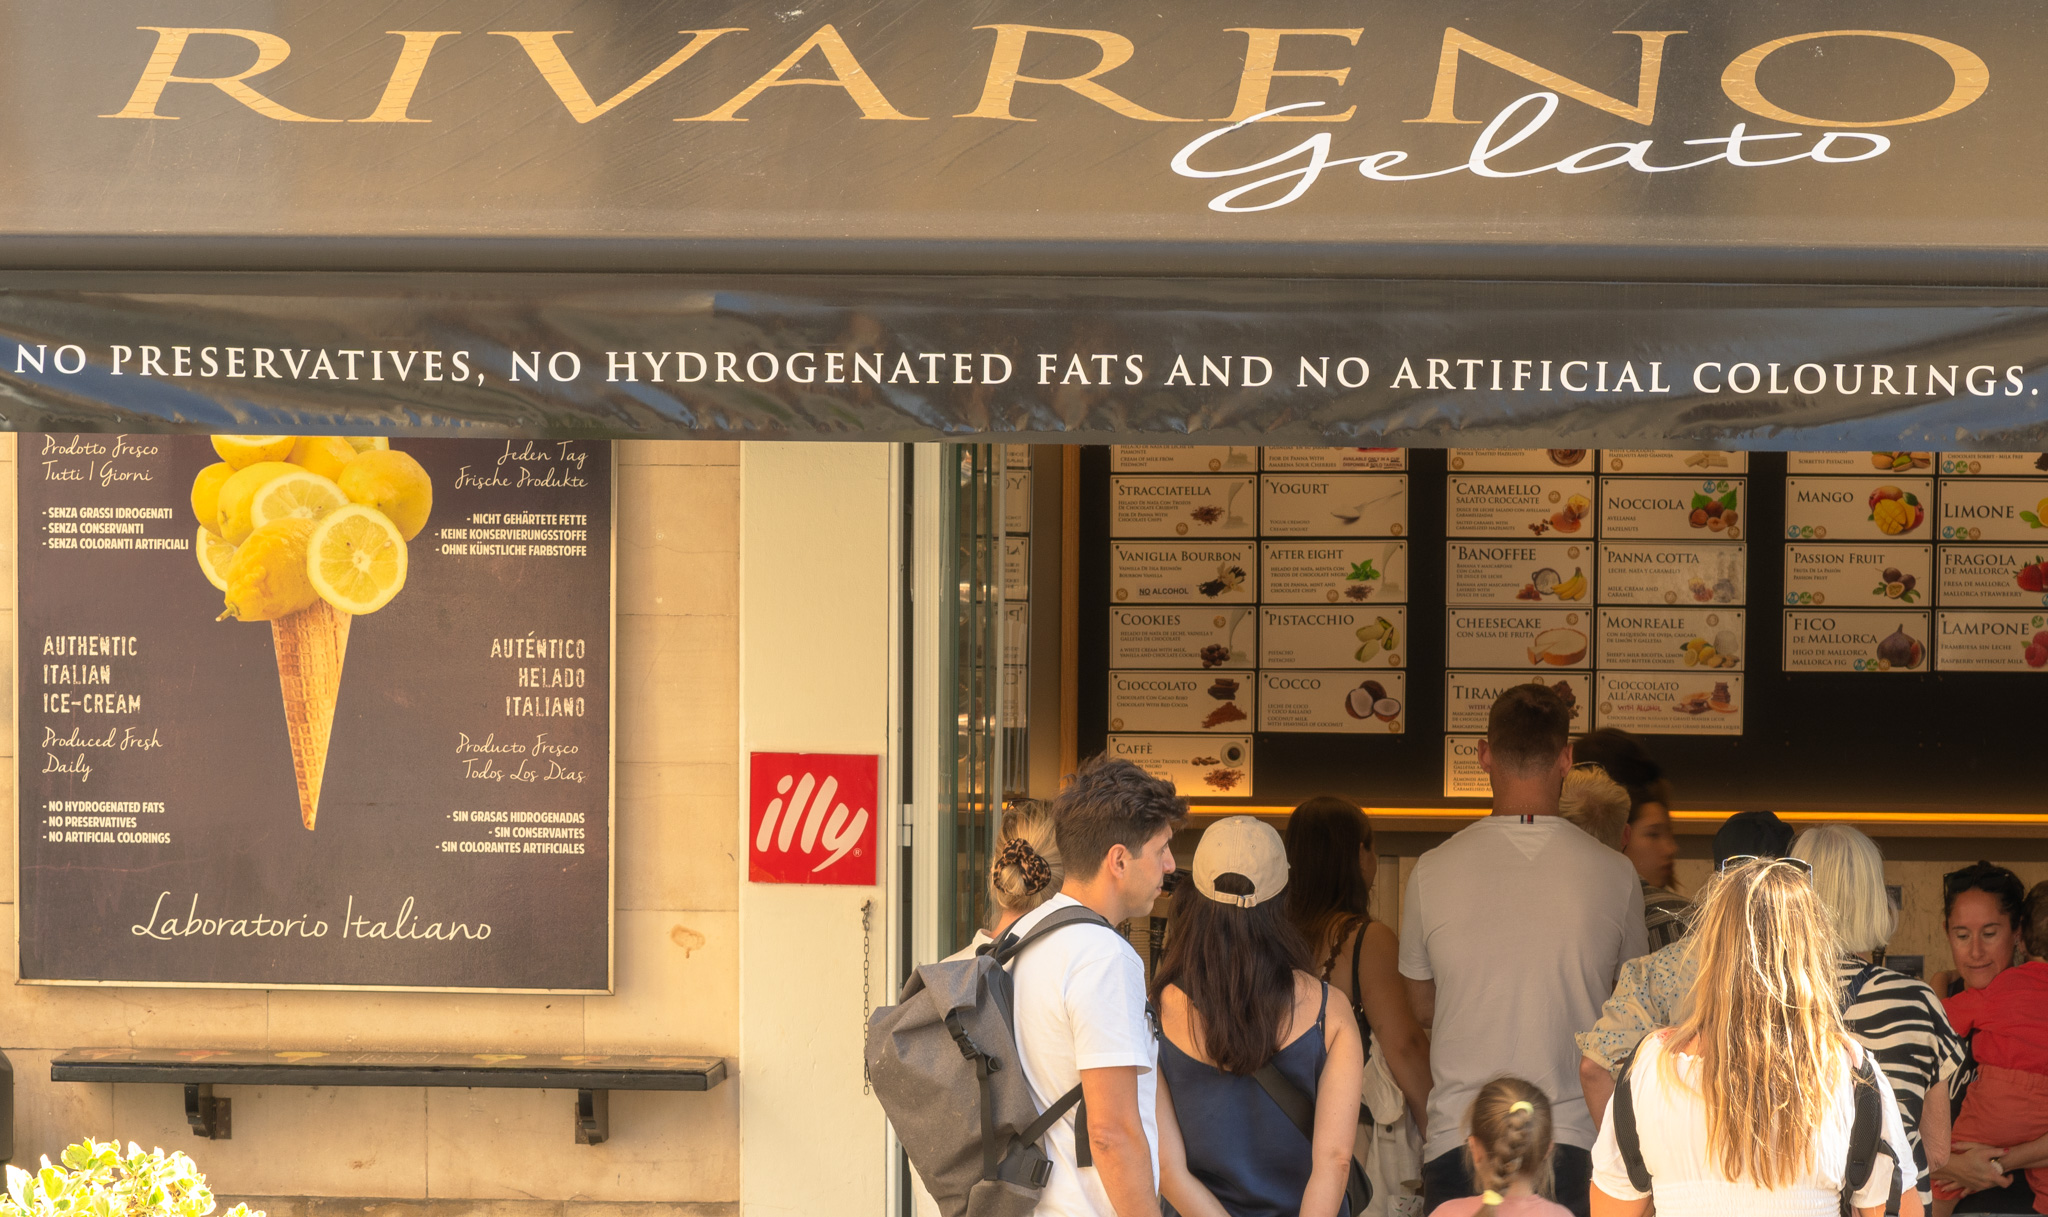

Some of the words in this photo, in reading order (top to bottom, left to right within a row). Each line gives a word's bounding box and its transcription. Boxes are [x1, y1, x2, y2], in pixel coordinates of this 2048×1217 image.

[97, 24, 1990, 127] RIVARENO
[1169, 91, 1891, 213] Gelato
[14, 344, 87, 375] NO
[110, 345, 485, 387] PRESERVATIVES,
[509, 350, 582, 383] NO
[606, 350, 1013, 385] HYDROGENATED
[1037, 354, 1144, 387] FATS
[1163, 355, 1273, 388] AND
[1297, 356, 1370, 388] NO
[1389, 357, 1670, 394] ARTIFICIAL
[1693, 361, 2039, 397] COLOURINGS.
[41, 433, 107, 456] Prodotto
[111, 433, 159, 459] Fresco
[497, 439, 552, 466] Jeden
[556, 439, 589, 470] Tag
[41, 459, 84, 481] Tutti
[99, 460, 154, 488] Giorni
[454, 464, 513, 490] Frische
[516, 466, 589, 488] Produkte
[1118, 483, 1212, 496] STRACCIATELLA
[1270, 482, 1330, 494] YOGURT
[1456, 482, 1541, 496] CARAMELLO
[1608, 497, 1685, 510] NOCCIOLA
[1797, 491, 1854, 503] MANGO
[48, 507, 78, 519] SENZA
[79, 507, 114, 519] GRASSI
[115, 507, 173, 519] IDROGENATI
[1944, 503, 2015, 519] LIMONE
[472, 513, 502, 525] NICHT
[503, 510, 558, 526] GEHÄRTETE
[559, 514, 587, 526] FETTE
[48, 522, 78, 534] SENZA
[79, 522, 144, 534] CONSERVANTI
[440, 528, 468, 541] KEINE
[469, 528, 587, 541] KONSERVIERUNGSSTOFFE
[48, 538, 78, 550] SENZA
[79, 538, 133, 550] COLORANTI
[134, 538, 189, 550] ARTIFICIALI
[441, 544, 468, 556] OHNE
[469, 542, 527, 556] KÜNSTLICHE
[528, 544, 587, 557] FARBSTOFFE
[1119, 550, 1178, 562] VANIGLIA
[1181, 550, 1242, 562] BOURBON
[1270, 550, 1305, 560] AFTER
[1308, 550, 1344, 560] EIGHT
[1458, 546, 1537, 561] BANOFFEE
[1608, 552, 1653, 564] PANNA
[1656, 552, 1700, 564] COTTA
[1794, 552, 1844, 564] PASSION
[1849, 552, 1885, 564] FRUIT
[1945, 554, 2016, 566] FRAGOLA
[1944, 567, 1957, 575] DE
[1958, 567, 2010, 575] MALLORCA
[1120, 613, 1180, 626] COOKIES
[1268, 614, 1354, 626] PISTACCHIO
[1456, 618, 1541, 629] CHEESECAKE
[1606, 616, 1685, 629] MONREALE
[1794, 618, 1836, 631] FICO
[1942, 620, 2030, 636] LAMPONE
[490, 630, 586, 659] AUTÉNTICO
[1792, 636, 1806, 644] DE
[1807, 634, 1878, 644] MALLORCA
[42, 636, 138, 656] AUTHENTIC
[43, 664, 111, 684] ITALIAN
[518, 667, 585, 688] HELADO
[1117, 680, 1198, 691] CIOCCOLATO
[1268, 676, 1321, 690] COCCO
[1608, 680, 1680, 691] CIOCCOLATO
[1452, 685, 1504, 700] TIRAM
[1607, 690, 1676, 702] ALL'ARANCIA
[43, 693, 141, 714] ICE-CREAM
[505, 696, 585, 717] ITALIANO
[42, 726, 116, 748] Produced
[120, 726, 164, 751] Fresh
[456, 732, 526, 754] Producto
[531, 732, 579, 757] Fresco
[1116, 742, 1153, 754] CAFFÈ
[42, 752, 93, 783] Daily
[462, 758, 505, 783] Todos
[510, 758, 539, 783] Los
[544, 759, 587, 784] Días
[48, 800, 64, 813] NO
[64, 800, 140, 813] HYDROGENATED
[142, 800, 166, 813] FATS
[48, 816, 64, 828] NO
[64, 816, 137, 828] PRESERVATIVES
[452, 810, 469, 824] SIN
[470, 810, 508, 824] GRASAS
[510, 810, 585, 824] HIDROGENADAS
[755, 771, 869, 873] illy
[48, 832, 64, 844] NO
[64, 832, 116, 844] ARTIFICIAL
[116, 832, 171, 844] COLORINGS
[494, 826, 510, 839] SIN
[512, 826, 585, 839] CONSERVANTES
[442, 841, 458, 854] SIN
[459, 841, 521, 854] COLORANTES
[522, 841, 585, 854] ARTIFICIALES
[130, 890, 328, 940] Laboratorio
[342, 894, 493, 941] Italiano
